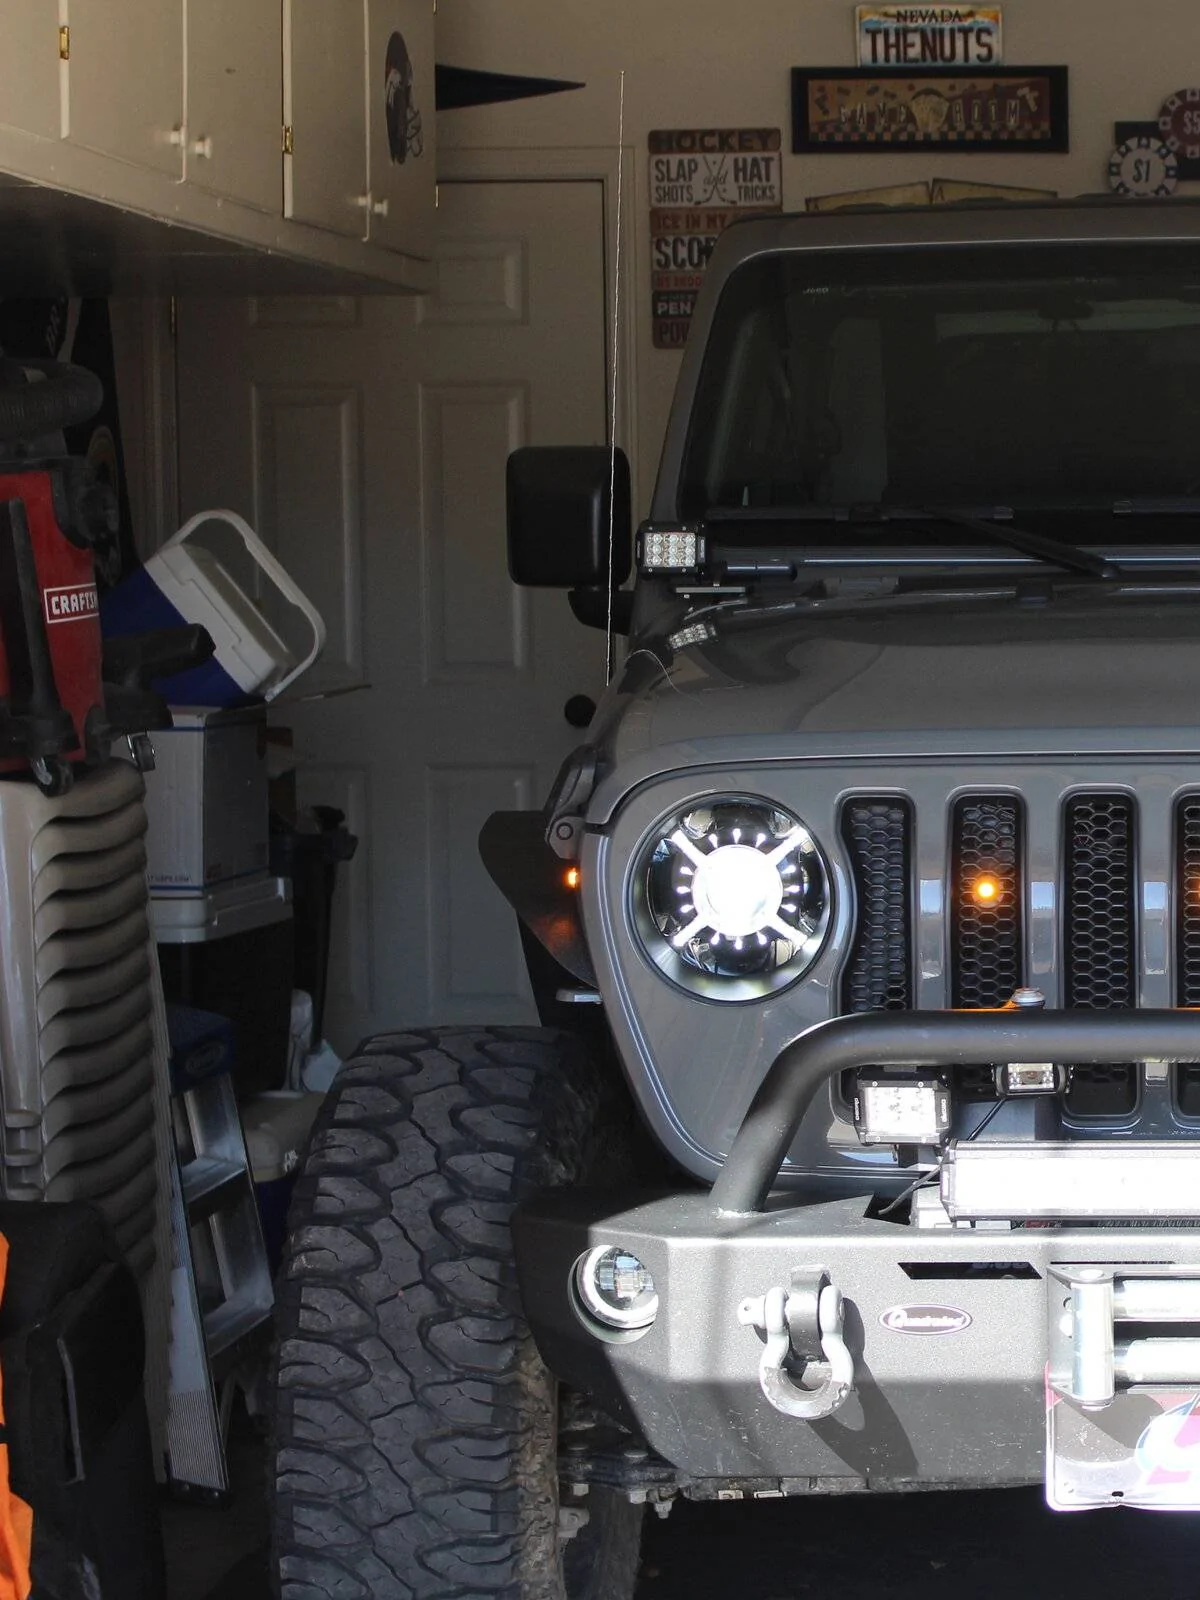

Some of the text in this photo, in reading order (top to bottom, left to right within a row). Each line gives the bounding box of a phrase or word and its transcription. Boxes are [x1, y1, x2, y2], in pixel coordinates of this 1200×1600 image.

[896, 9, 962, 23] NEVADA
[865, 27, 993, 64] THENUTS
[653, 131, 776, 152] HOCKEY
[655, 158, 698, 183] SLAP
[734, 157, 774, 183] HAT
[1132, 158, 1150, 183] $1
[655, 184, 775, 203] SHOTS TRICKS
[685, 214, 701, 229] IN
[706, 213, 728, 229] MY
